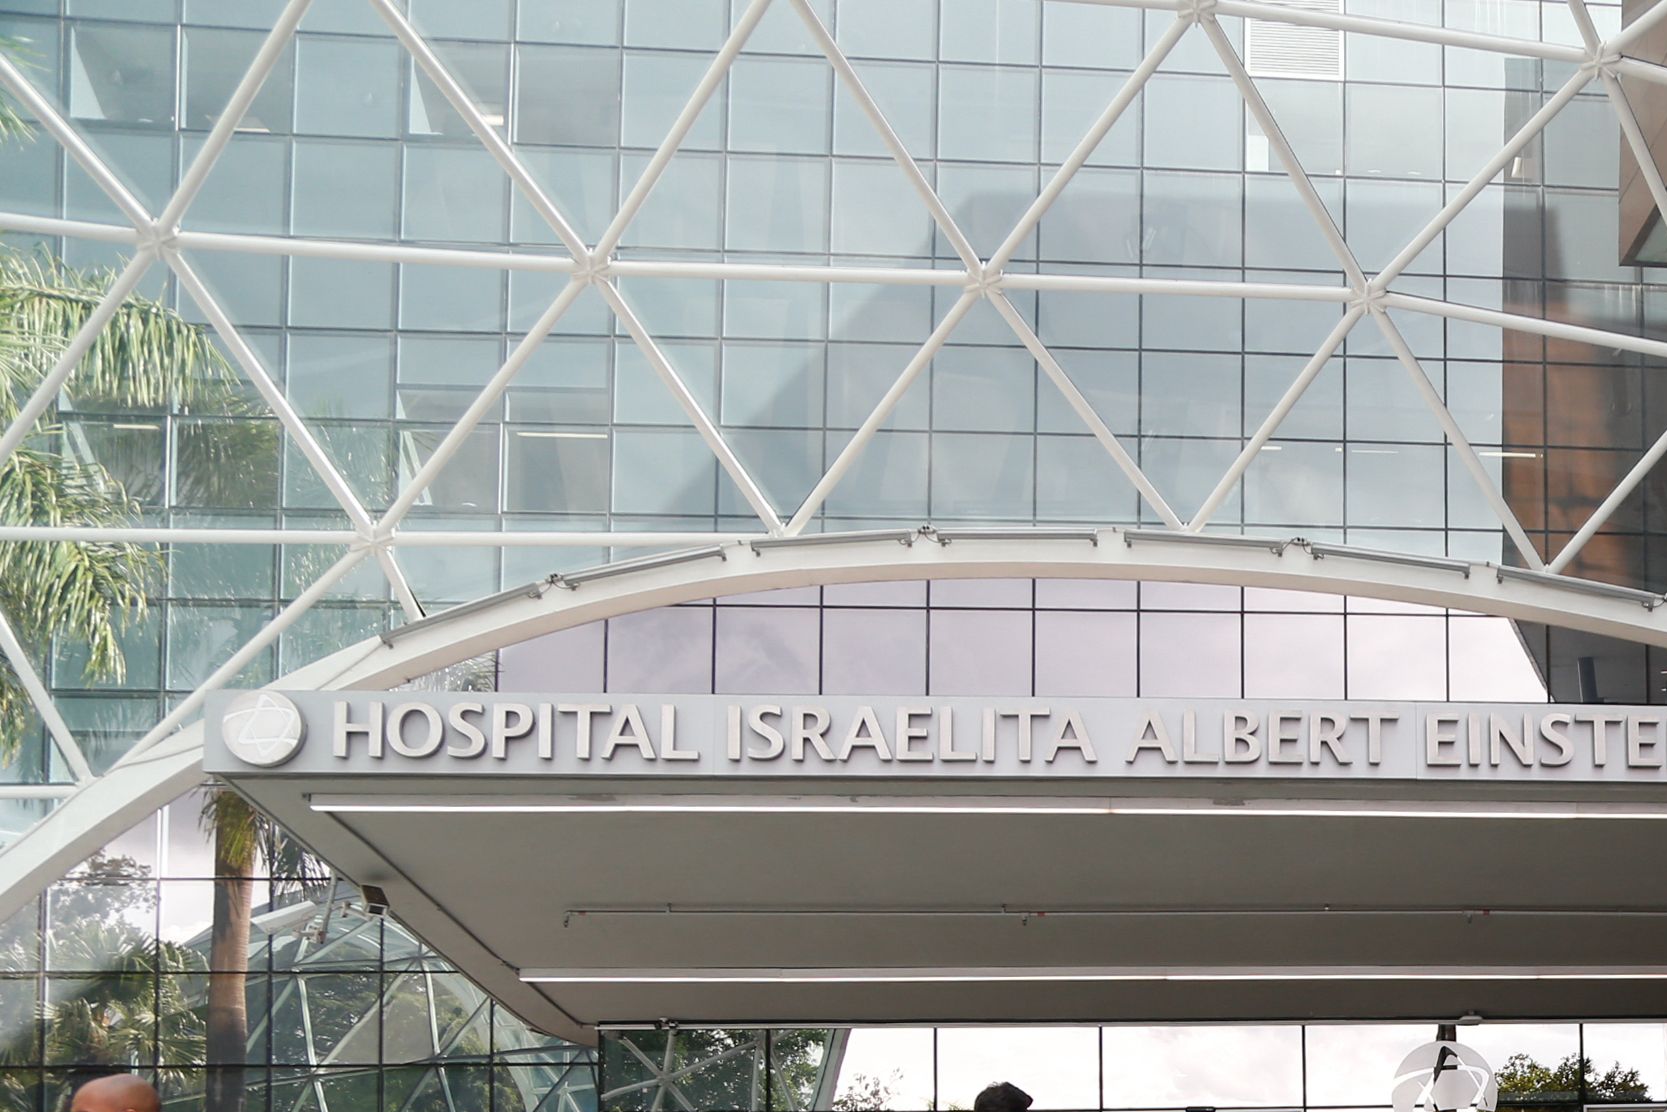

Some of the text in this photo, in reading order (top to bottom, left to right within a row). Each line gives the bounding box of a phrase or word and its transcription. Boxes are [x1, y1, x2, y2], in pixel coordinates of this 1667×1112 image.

[333, 700, 699, 761] HOSPITAL
[727, 704, 1097, 763] ISRAELITA
[1126, 708, 1399, 765] ALBERT
